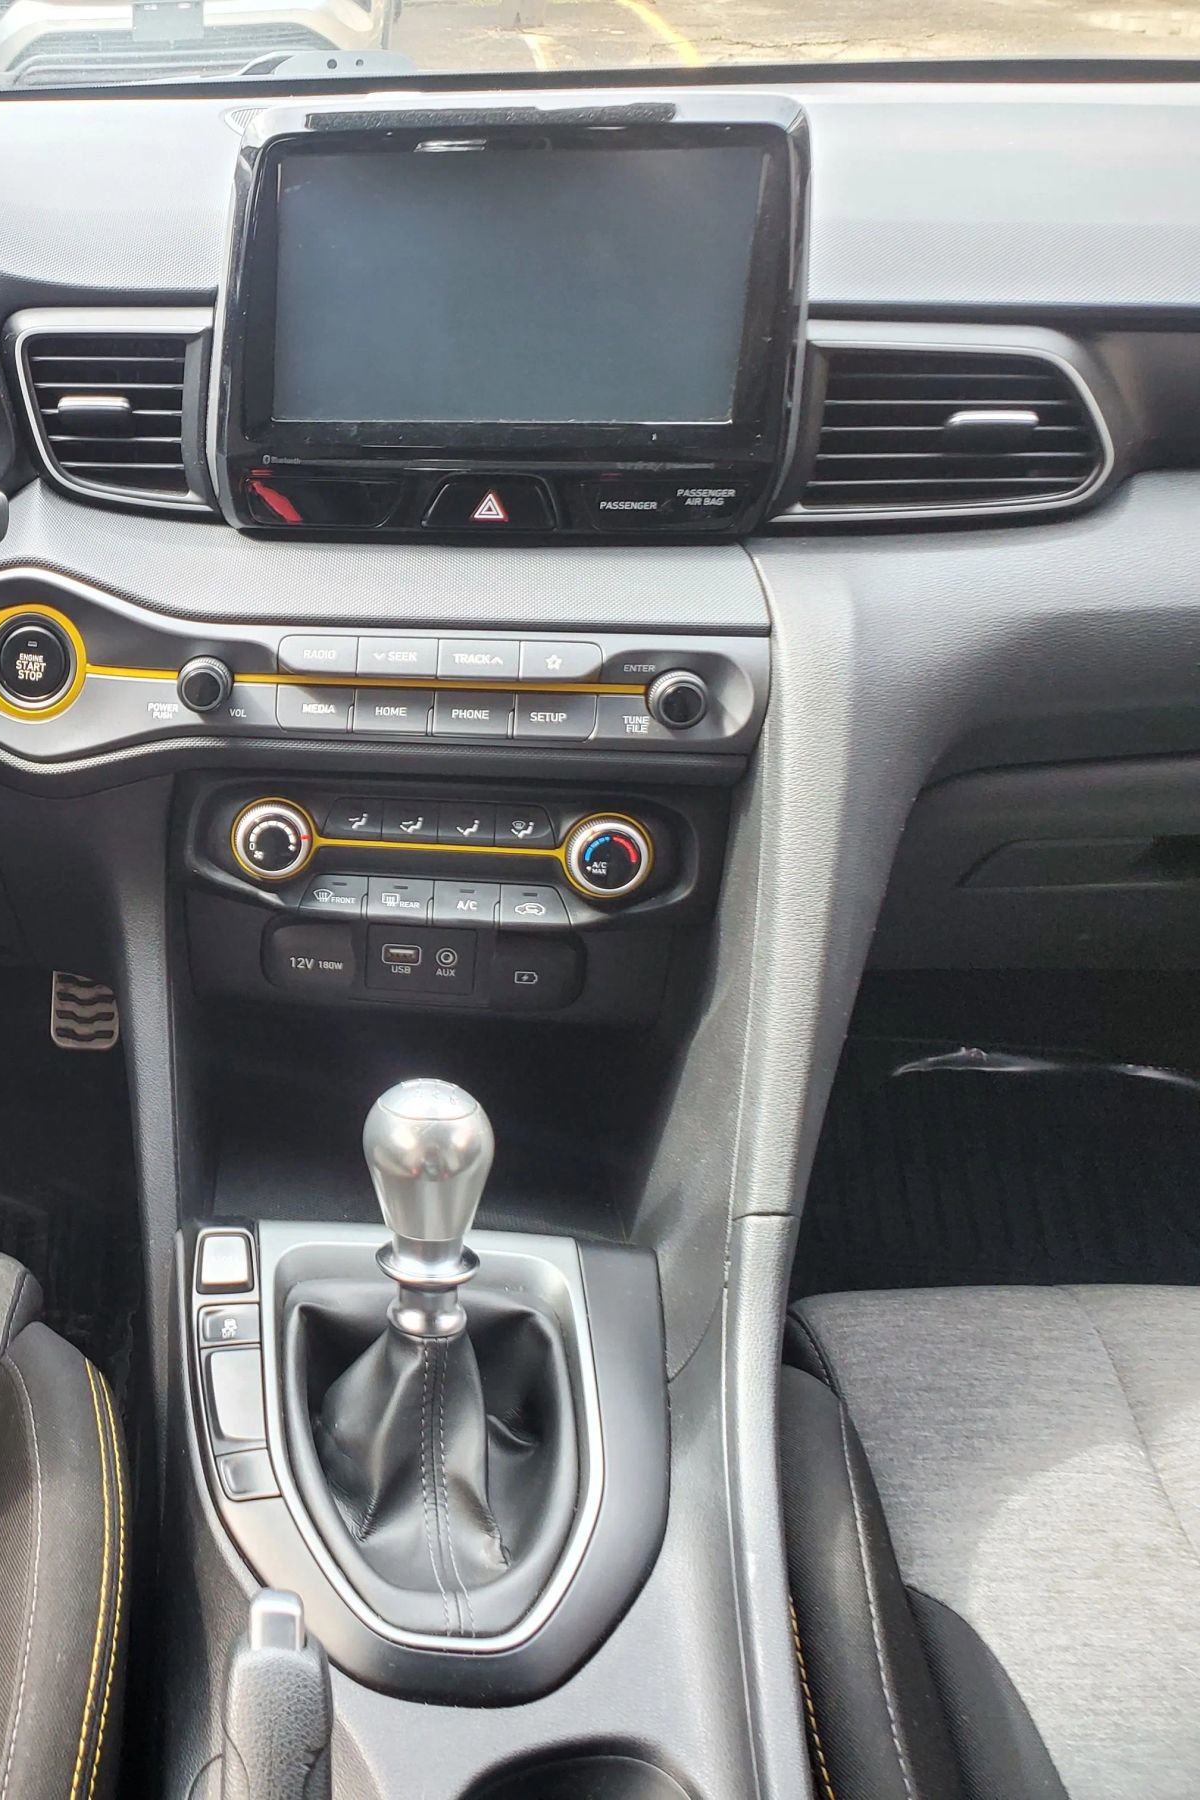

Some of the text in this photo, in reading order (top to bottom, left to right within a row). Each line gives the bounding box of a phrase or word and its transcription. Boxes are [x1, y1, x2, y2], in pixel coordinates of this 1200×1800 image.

[677, 489, 736, 497] PASSENGER
[599, 501, 658, 510] PASSENGER
[684, 498, 725, 506] AIR BAG
[19, 653, 44, 662] ENGINE
[303, 649, 337, 660] RADIO
[387, 651, 418, 662] SEEK
[453, 653, 491, 665] TRACK
[16, 660, 46, 672] START
[623, 664, 656, 673] ENTER
[18, 670, 43, 681] STOP
[147, 702, 179, 713] POWER
[302, 703, 336, 715] MEDIA
[375, 706, 408, 717] HOME
[152, 710, 173, 720] PUSH
[229, 708, 247, 718] VOL
[451, 709, 490, 720] PHONE
[530, 712, 567, 723] SETUP
[622, 715, 650, 725] TUNE
[625, 723, 649, 734] FILE
[591, 861, 608, 869] A/C
[330, 896, 356, 905] FRONT
[399, 901, 420, 909] REAR
[456, 900, 478, 910] A/C
[289, 956, 343, 970] 12V 180W
[391, 964, 411, 974] USB
[435, 968, 456, 977] AUX
[221, 1328, 237, 1339] OFF
